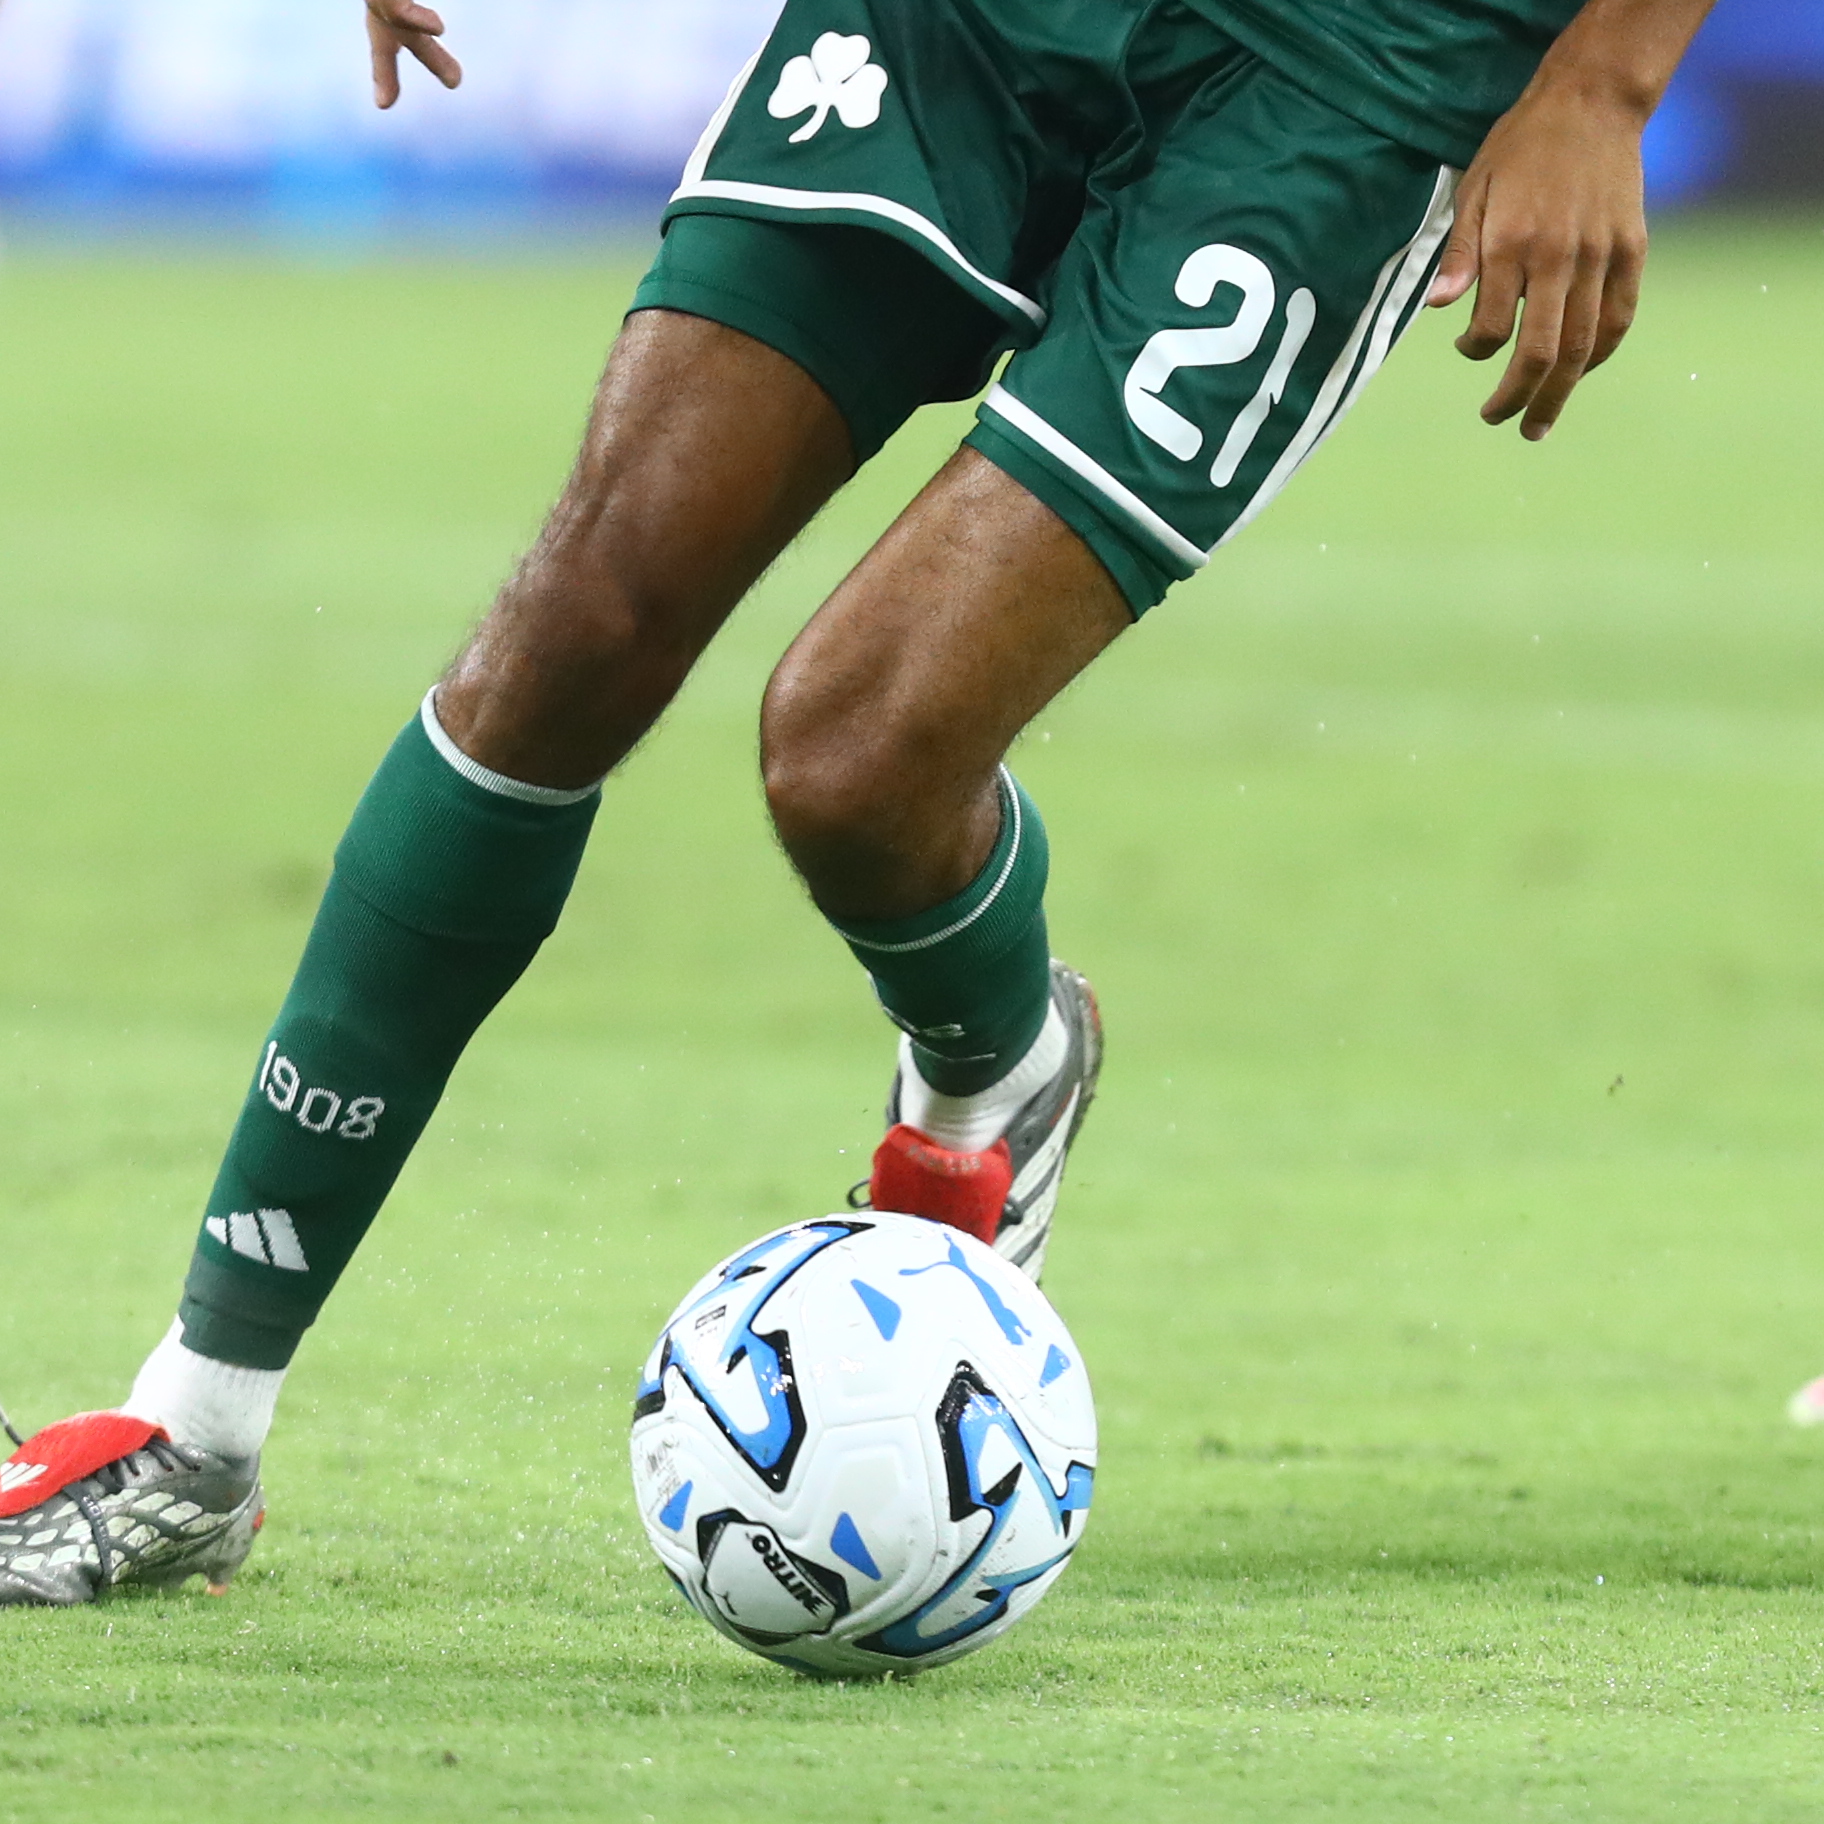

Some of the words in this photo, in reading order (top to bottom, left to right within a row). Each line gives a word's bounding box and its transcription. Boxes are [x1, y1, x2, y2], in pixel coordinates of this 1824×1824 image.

[1124, 243, 1317, 489] 21
[259, 1040, 386, 1139] 1908
[751, 1534, 828, 1618] NITRO
